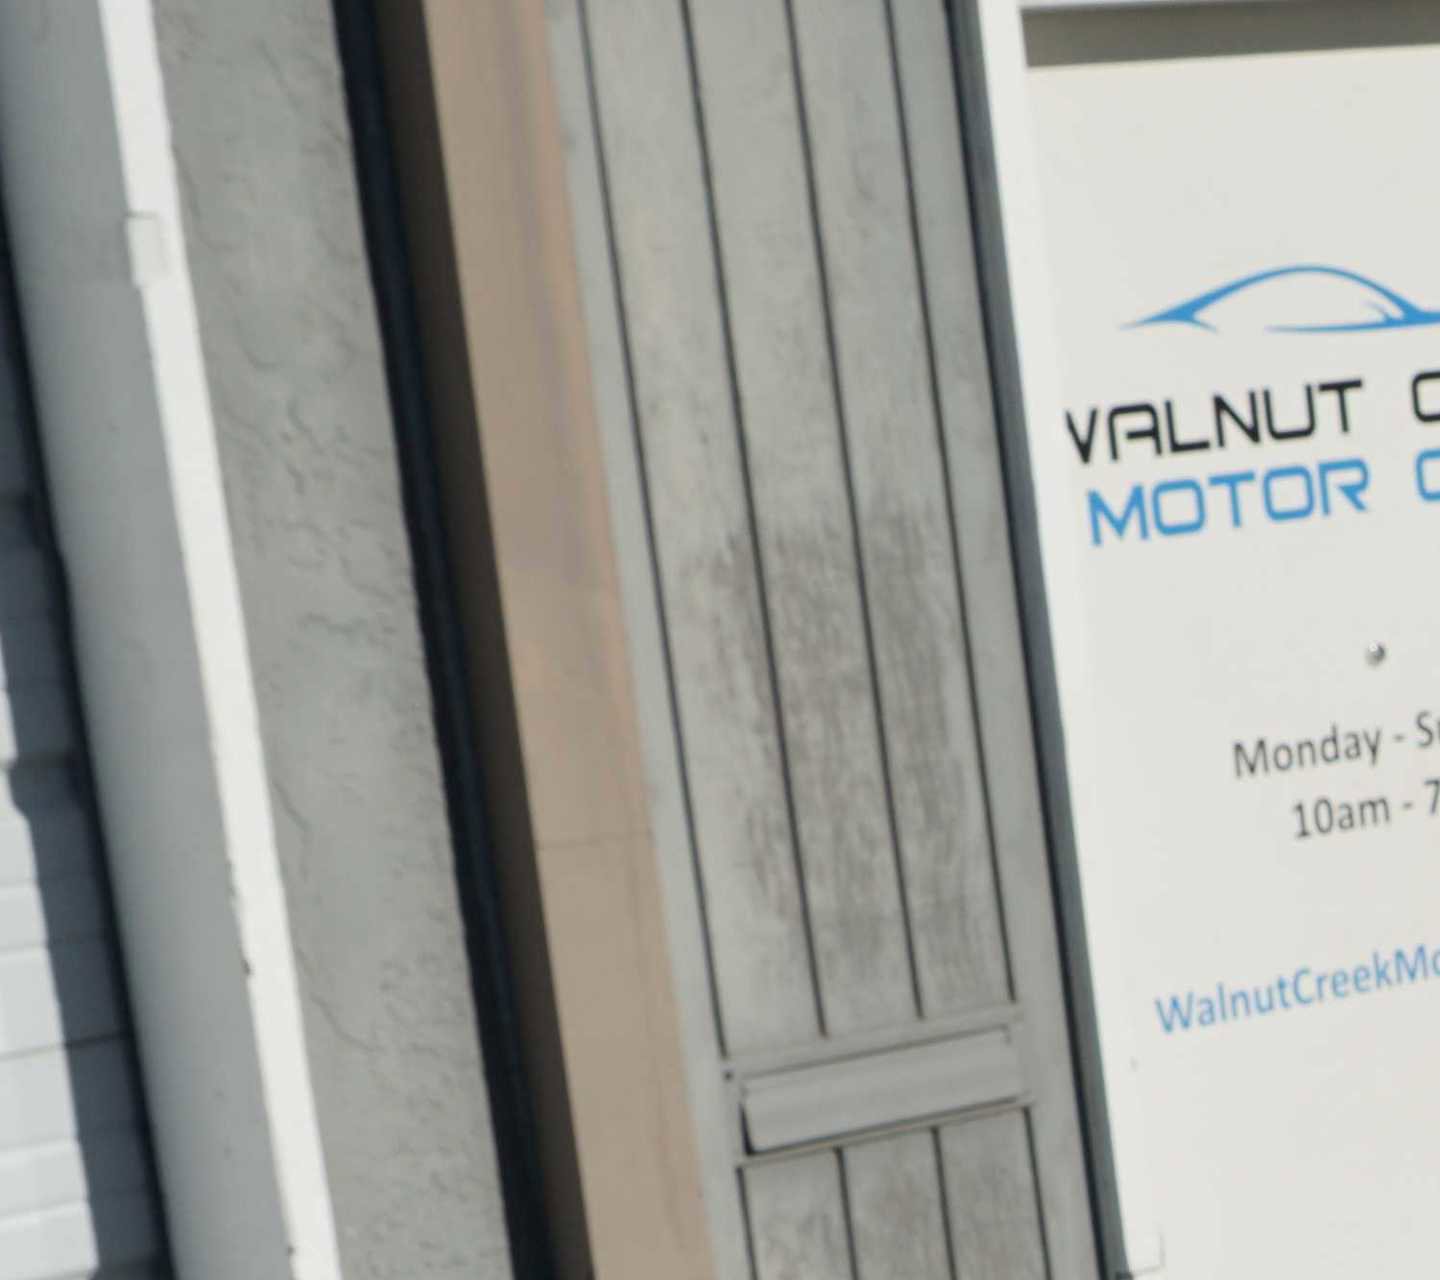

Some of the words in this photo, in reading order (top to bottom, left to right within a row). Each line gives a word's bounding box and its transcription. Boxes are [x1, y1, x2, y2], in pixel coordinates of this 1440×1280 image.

[1087, 458, 1369, 546] MOTOR
[1231, 721, 1382, 780] Monday
[1293, 796, 1390, 839] 10am
